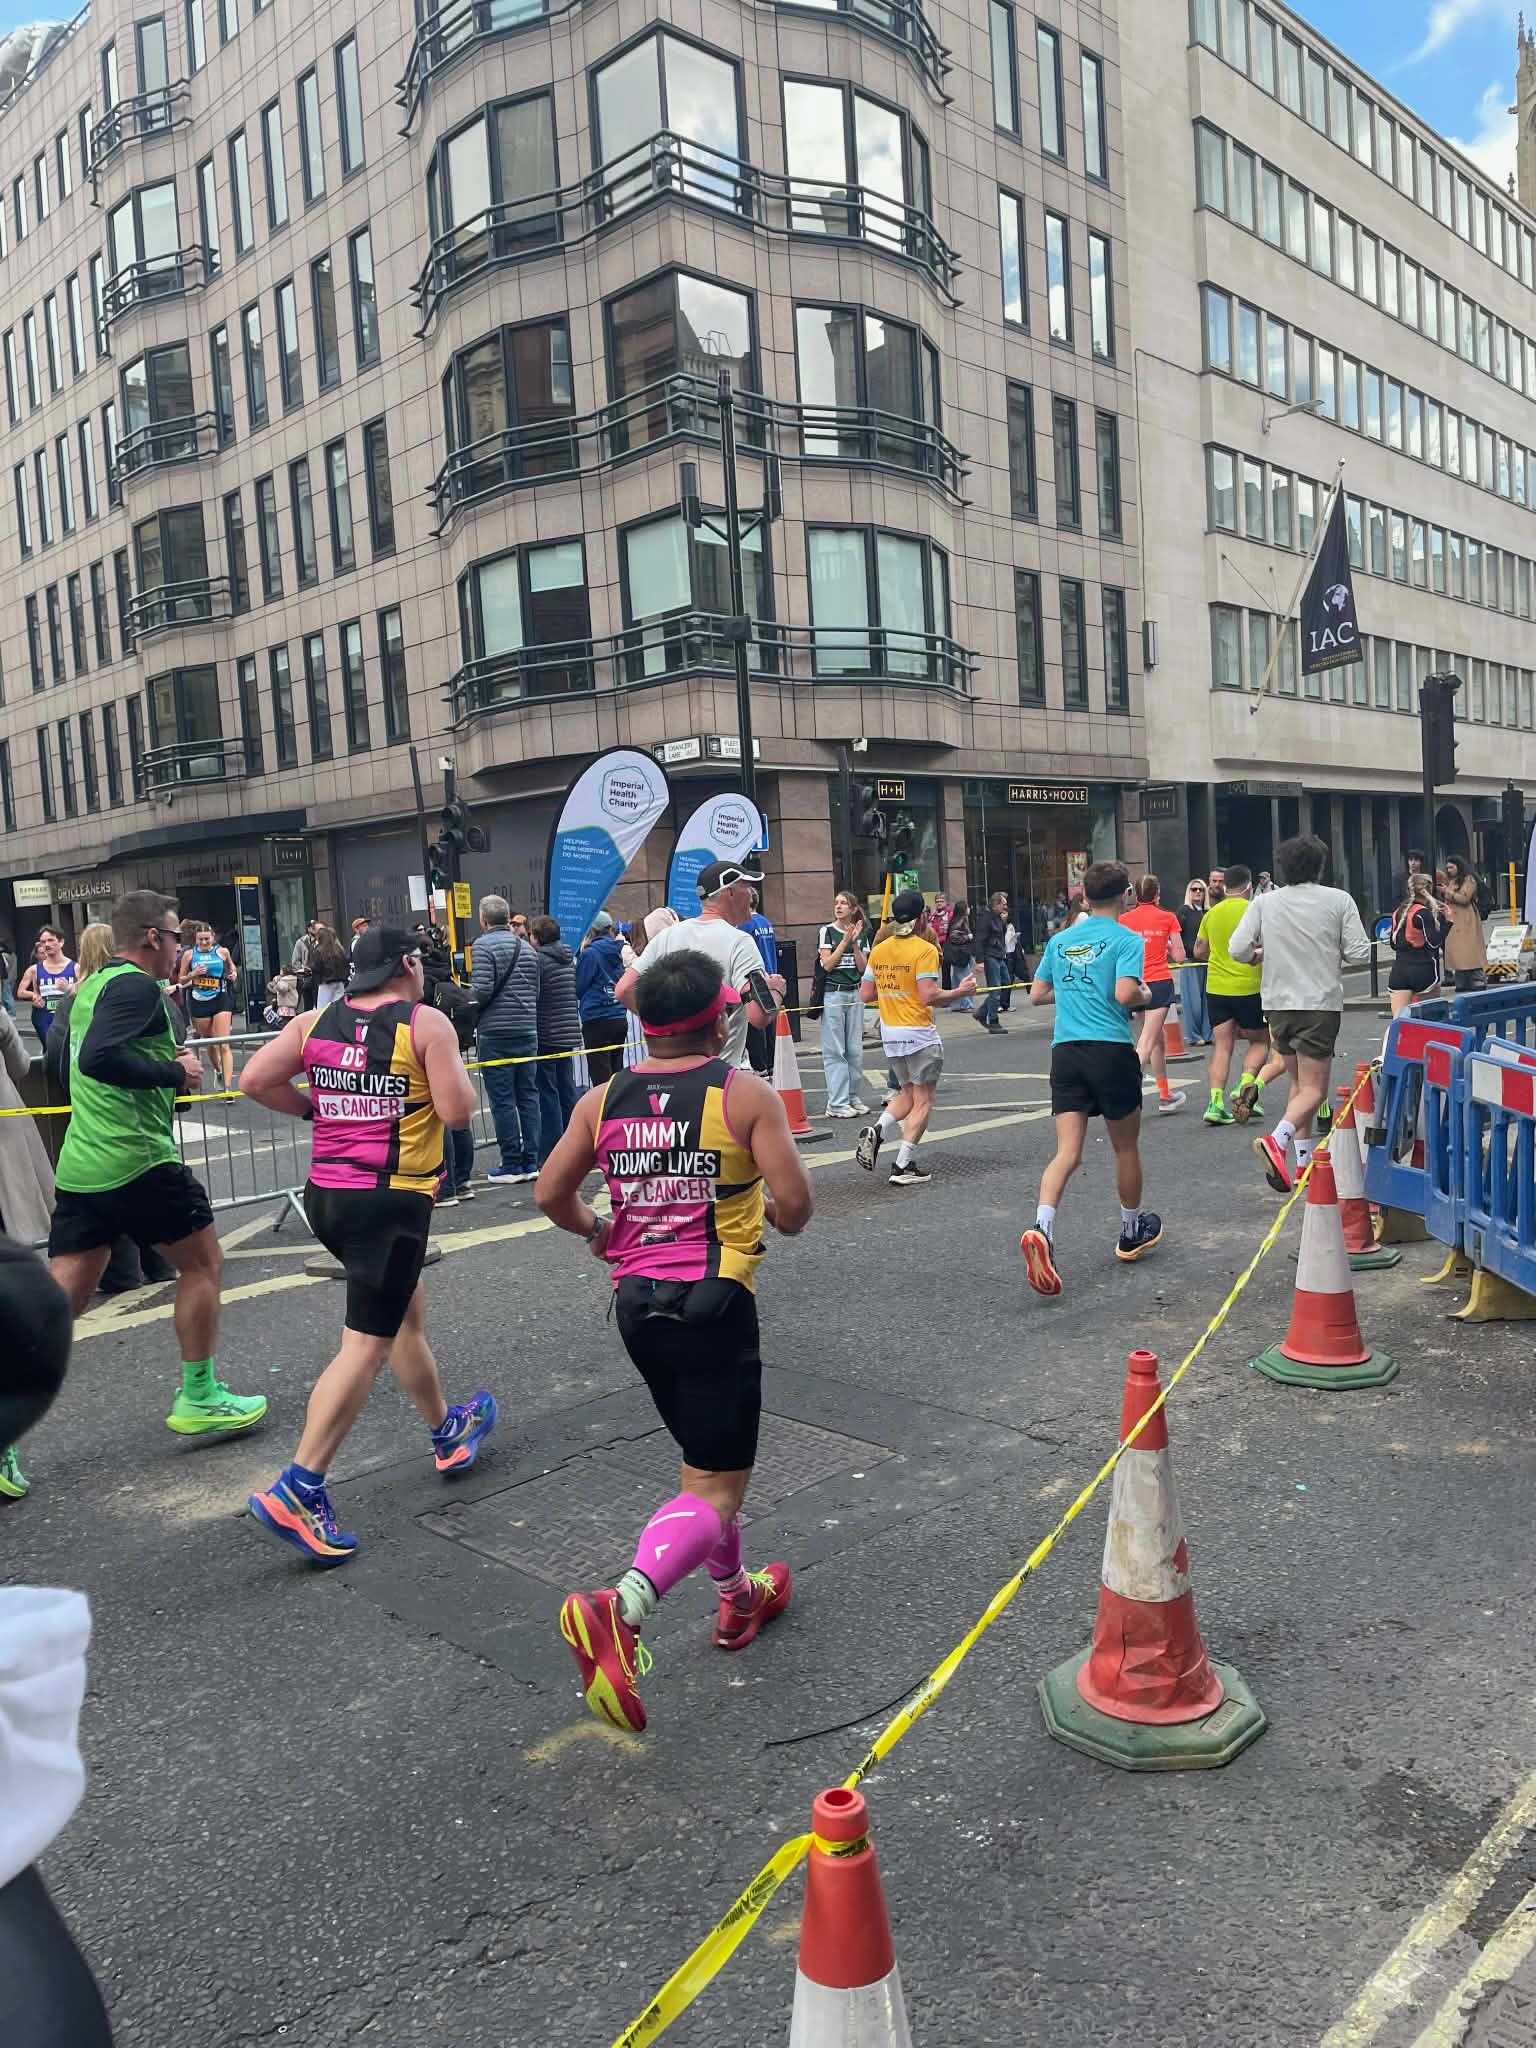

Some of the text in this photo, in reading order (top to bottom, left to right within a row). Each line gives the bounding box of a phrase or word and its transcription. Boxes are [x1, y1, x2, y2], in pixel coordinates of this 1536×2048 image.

[1309, 621, 1355, 653] IAC
[609, 789, 637, 799] Health
[610, 779, 644, 790] Imperial
[609, 798, 639, 810] Charity
[717, 820, 739, 829] Health
[718, 814, 745, 823] Imperial
[716, 828, 739, 837] Charity
[57, 881, 111, 900] DRYCLEANERS
[341, 1046, 365, 1068] DC
[312, 1066, 406, 1096] YOUNG LIVES
[321, 1098, 400, 1117] vs CANCER
[622, 1121, 690, 1149] YIMMY
[609, 1152, 717, 1176] YOUNG LIVES
[642, 1178, 713, 1201] CANCER
